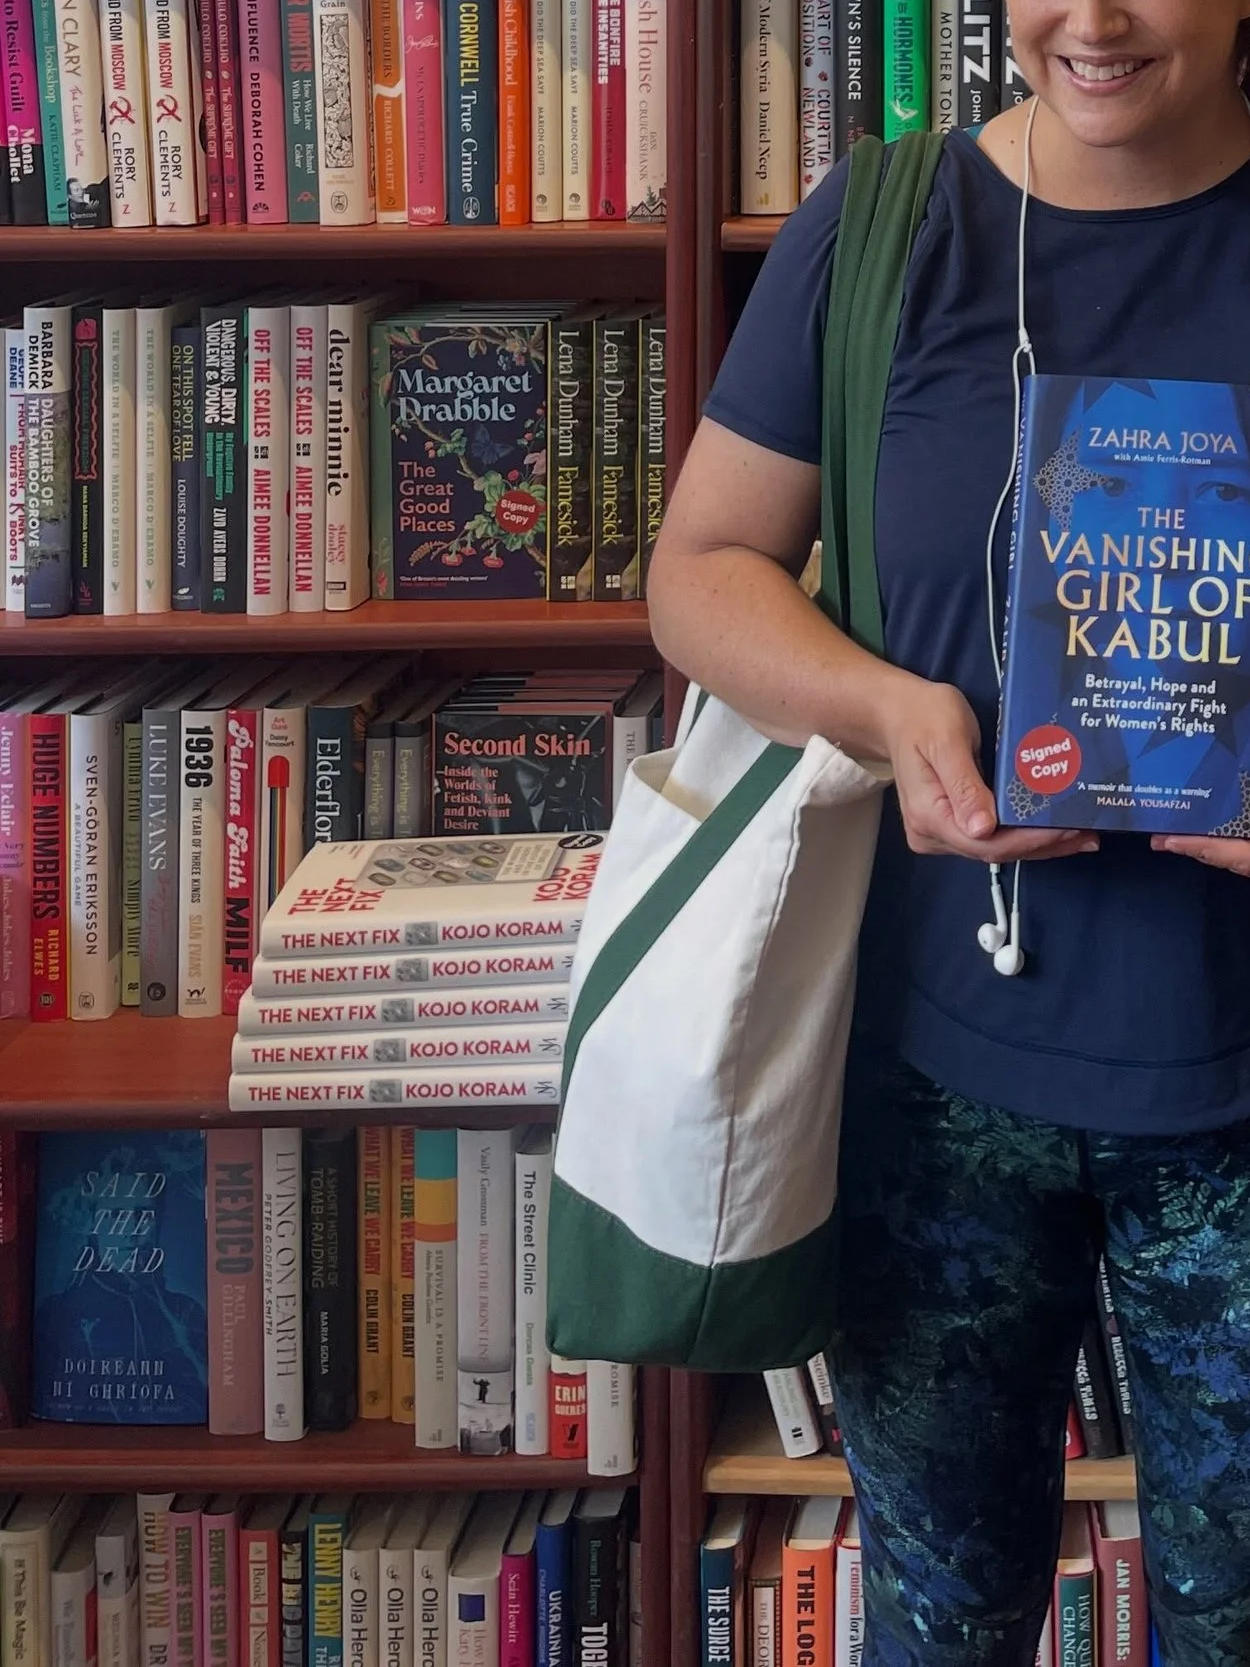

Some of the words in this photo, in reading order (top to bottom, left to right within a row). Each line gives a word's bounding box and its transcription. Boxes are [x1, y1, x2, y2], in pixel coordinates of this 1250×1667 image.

[459, 5, 480, 86] CORNWELL
[971, 90, 981, 122] JOHN
[398, 369, 533, 399] Margaret
[400, 397, 515, 423] Drabble
[1089, 428, 1171, 451] ZAHRA
[1180, 432, 1238, 454] JOYA
[399, 462, 436, 479] The
[399, 480, 453, 497] Great
[399, 498, 451, 516] Good
[1138, 507, 1185, 529] THE
[399, 516, 456, 533] Places
[1056, 569, 1173, 616] GIRL
[1066, 616, 1241, 664] KABUL
[1085, 674, 1146, 694] Betrayal,
[1151, 678, 1187, 694] Hope
[1190, 680, 1216, 694] and
[1072, 696, 1088, 707] an
[1092, 694, 1186, 715] Extraordinary
[1190, 699, 1226, 715] Fight
[1080, 713, 1101, 728] for
[1104, 715, 1167, 732] Women's
[1171, 718, 1215, 737] Rights
[443, 732, 527, 756] Second
[534, 733, 592, 756] Skin
[1020, 738, 1071, 763] Signed
[31, 732, 60, 786] HUGE
[1031, 759, 1069, 780] Copy
[1097, 796, 1136, 806] MALALA
[1139, 798, 1191, 810] YOUSAFZAI
[32, 793, 60, 920] NUMBERS
[248, 1086, 281, 1102] THE
[287, 1086, 332, 1102] NEXT
[337, 1085, 364, 1101] FIX
[405, 1083, 453, 1099] KOJO
[458, 1081, 526, 1097] KORAM
[81, 1171, 166, 1196] SAID
[89, 1210, 156, 1236] THE
[215, 1162, 254, 1275] MEXICO
[73, 1245, 165, 1273] DEAD
